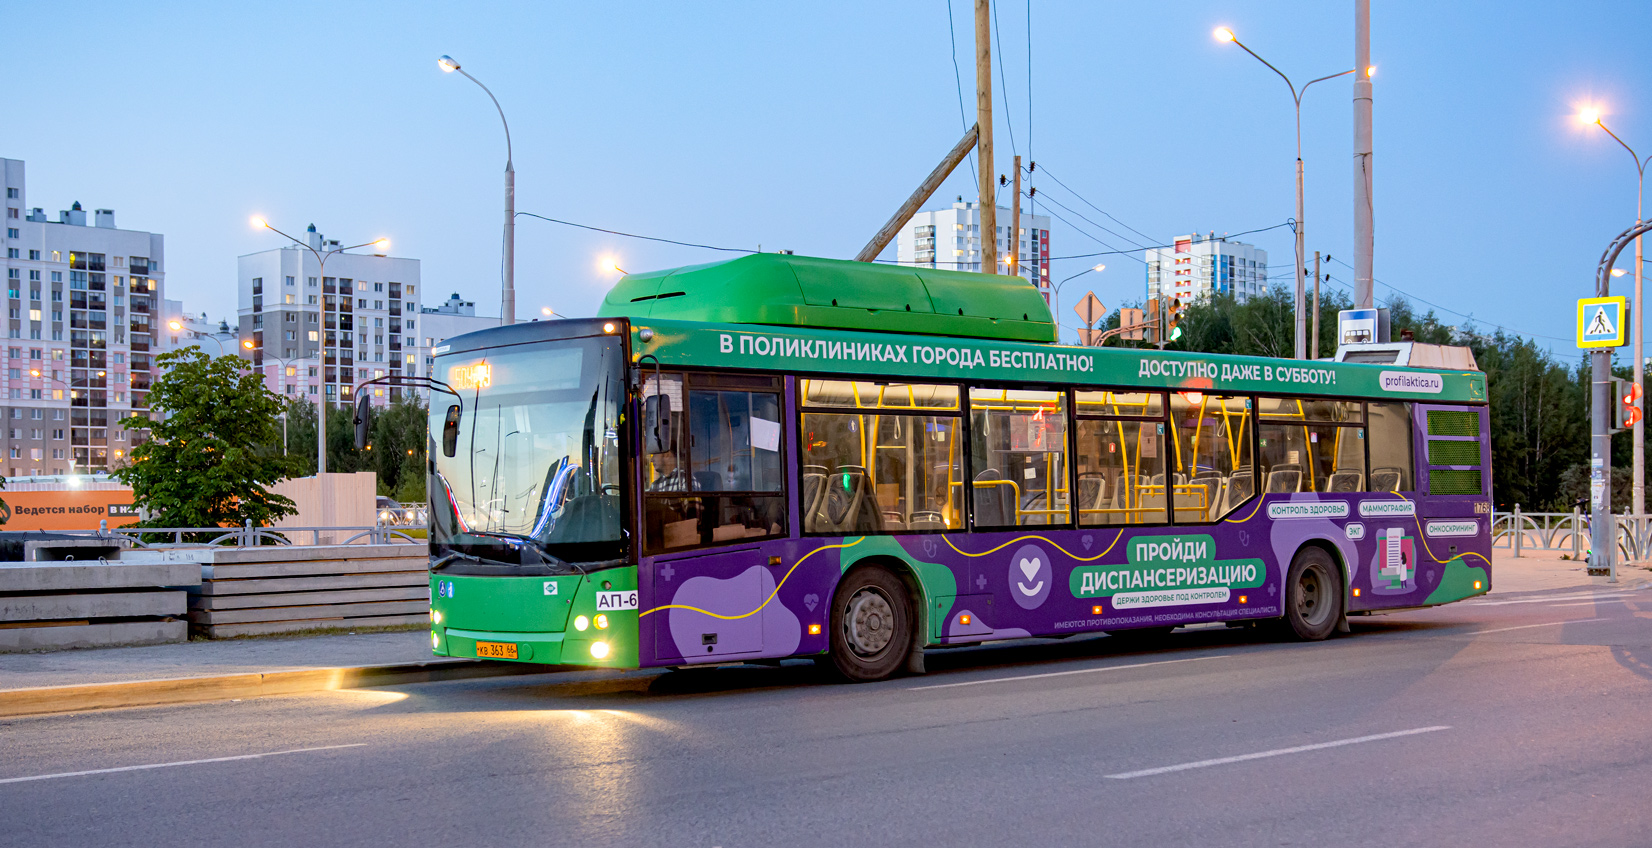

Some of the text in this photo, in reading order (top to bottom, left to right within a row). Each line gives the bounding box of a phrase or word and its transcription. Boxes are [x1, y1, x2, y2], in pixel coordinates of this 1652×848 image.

[719, 334, 1094, 372] В ПОЛИКЛИНИКАХ ГОРОДА БЕСПЛАТНО!
[1138, 359, 1336, 385] ДОСТУПНО ДАЖЕ В СУББОТУ!
[1385, 375, 1439, 389] profilaktica.ru
[15, 505, 66, 516] Ведется
[68, 506, 105, 516] набор
[1271, 505, 1345, 515] КОНТРОЛЬ ЗДОРОВЬЯ
[1362, 504, 1413, 513] МАММОГРАФИЯ
[1349, 527, 1361, 536] ЭКГ
[1429, 524, 1476, 533] ОНКОСКРИНИНГ
[1136, 538, 1207, 563] ПРОЙДИ
[1080, 564, 1257, 595] ДИСПАНСЕРИЗАЦИЮ
[598, 593, 637, 608] АП-6
[1116, 591, 1227, 606] ДЕРЖИ ЗДОРОВЬЕ ПОД КОНТРОЛЕМ
[1054, 620, 1086, 629] ИМЕЮТСЯ
[1154, 611, 1195, 622] НЕОБХОДИМА
[1195, 608, 1238, 618] КОНСУЛЬТАЦИЯ
[1238, 605, 1278, 616] СПЕЦИАЛИСТА
[490, 645, 504, 656] 363
